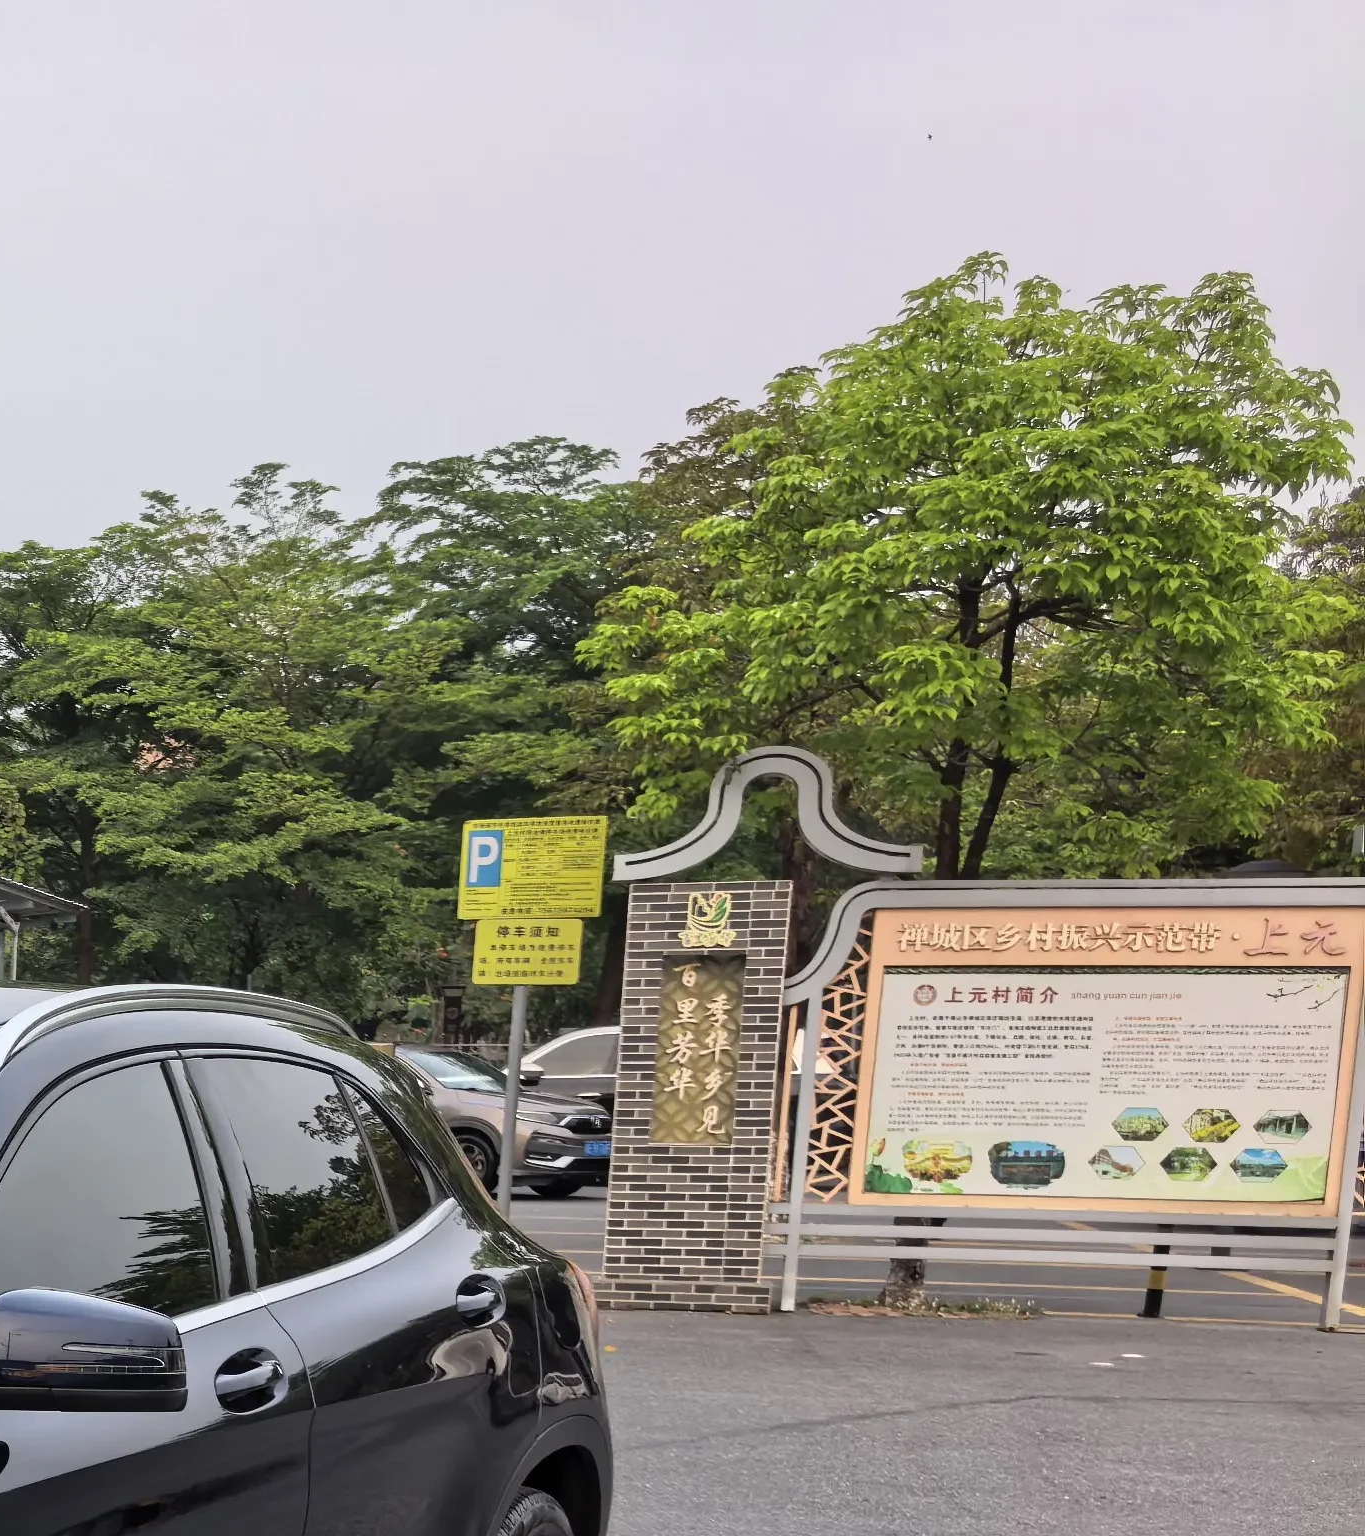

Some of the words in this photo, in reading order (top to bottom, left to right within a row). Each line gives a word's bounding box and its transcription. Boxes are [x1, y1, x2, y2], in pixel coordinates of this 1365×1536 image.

[469, 836, 499, 883] P
[664, 963, 701, 1100] 百里芳华
[944, 986, 1059, 1005] 上元村简介
[696, 993, 734, 1134] 季华乡见
